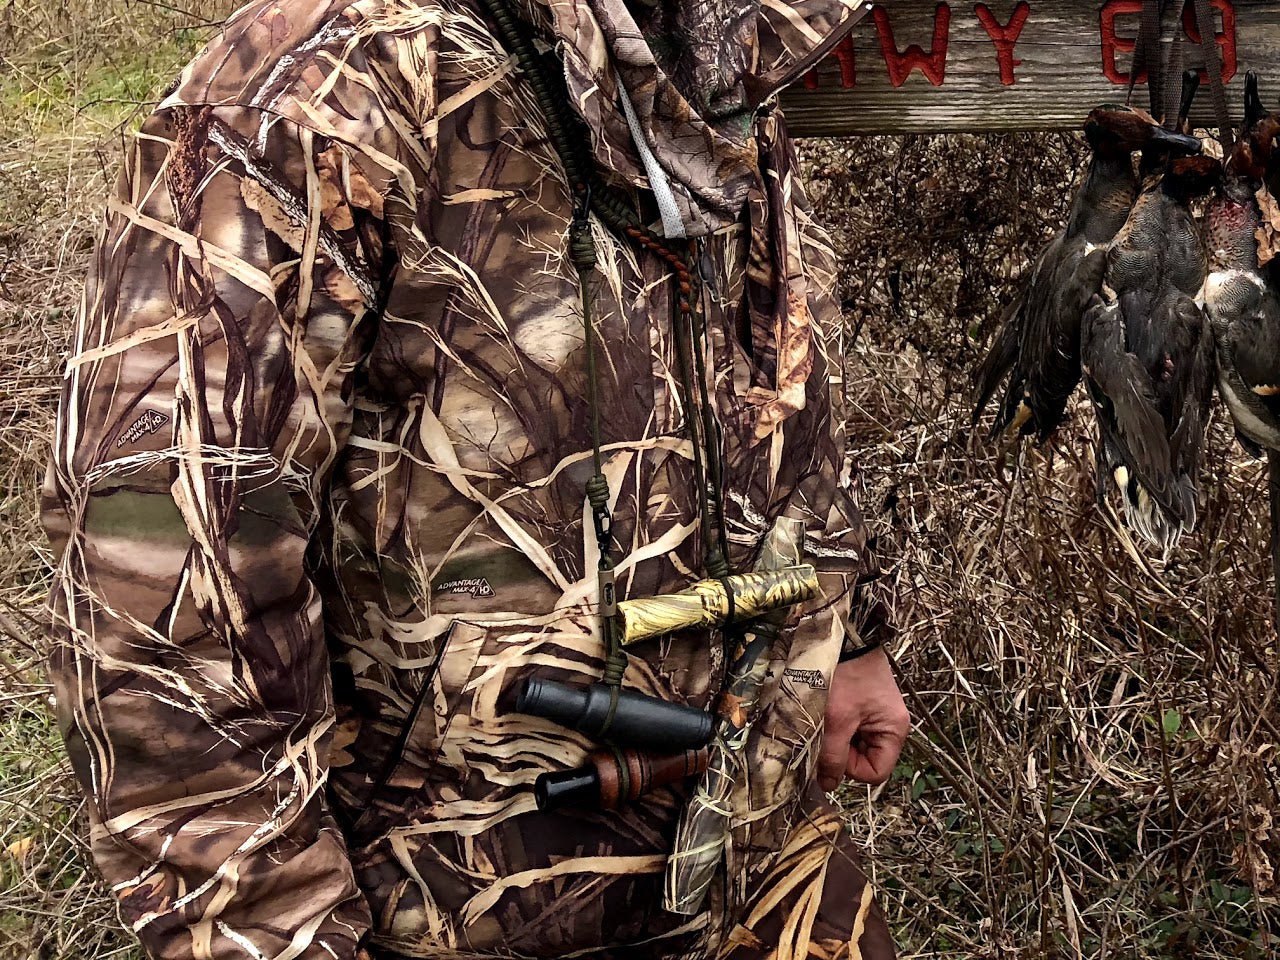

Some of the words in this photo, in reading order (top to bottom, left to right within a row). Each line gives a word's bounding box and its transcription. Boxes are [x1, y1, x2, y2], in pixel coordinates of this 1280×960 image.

[152, 415, 162, 426] HD
[117, 413, 150, 448] ADVANTAGE
[437, 578, 481, 590] ADVANTAGE
[479, 585, 490, 595] HD
[814, 678, 824, 686] HD
